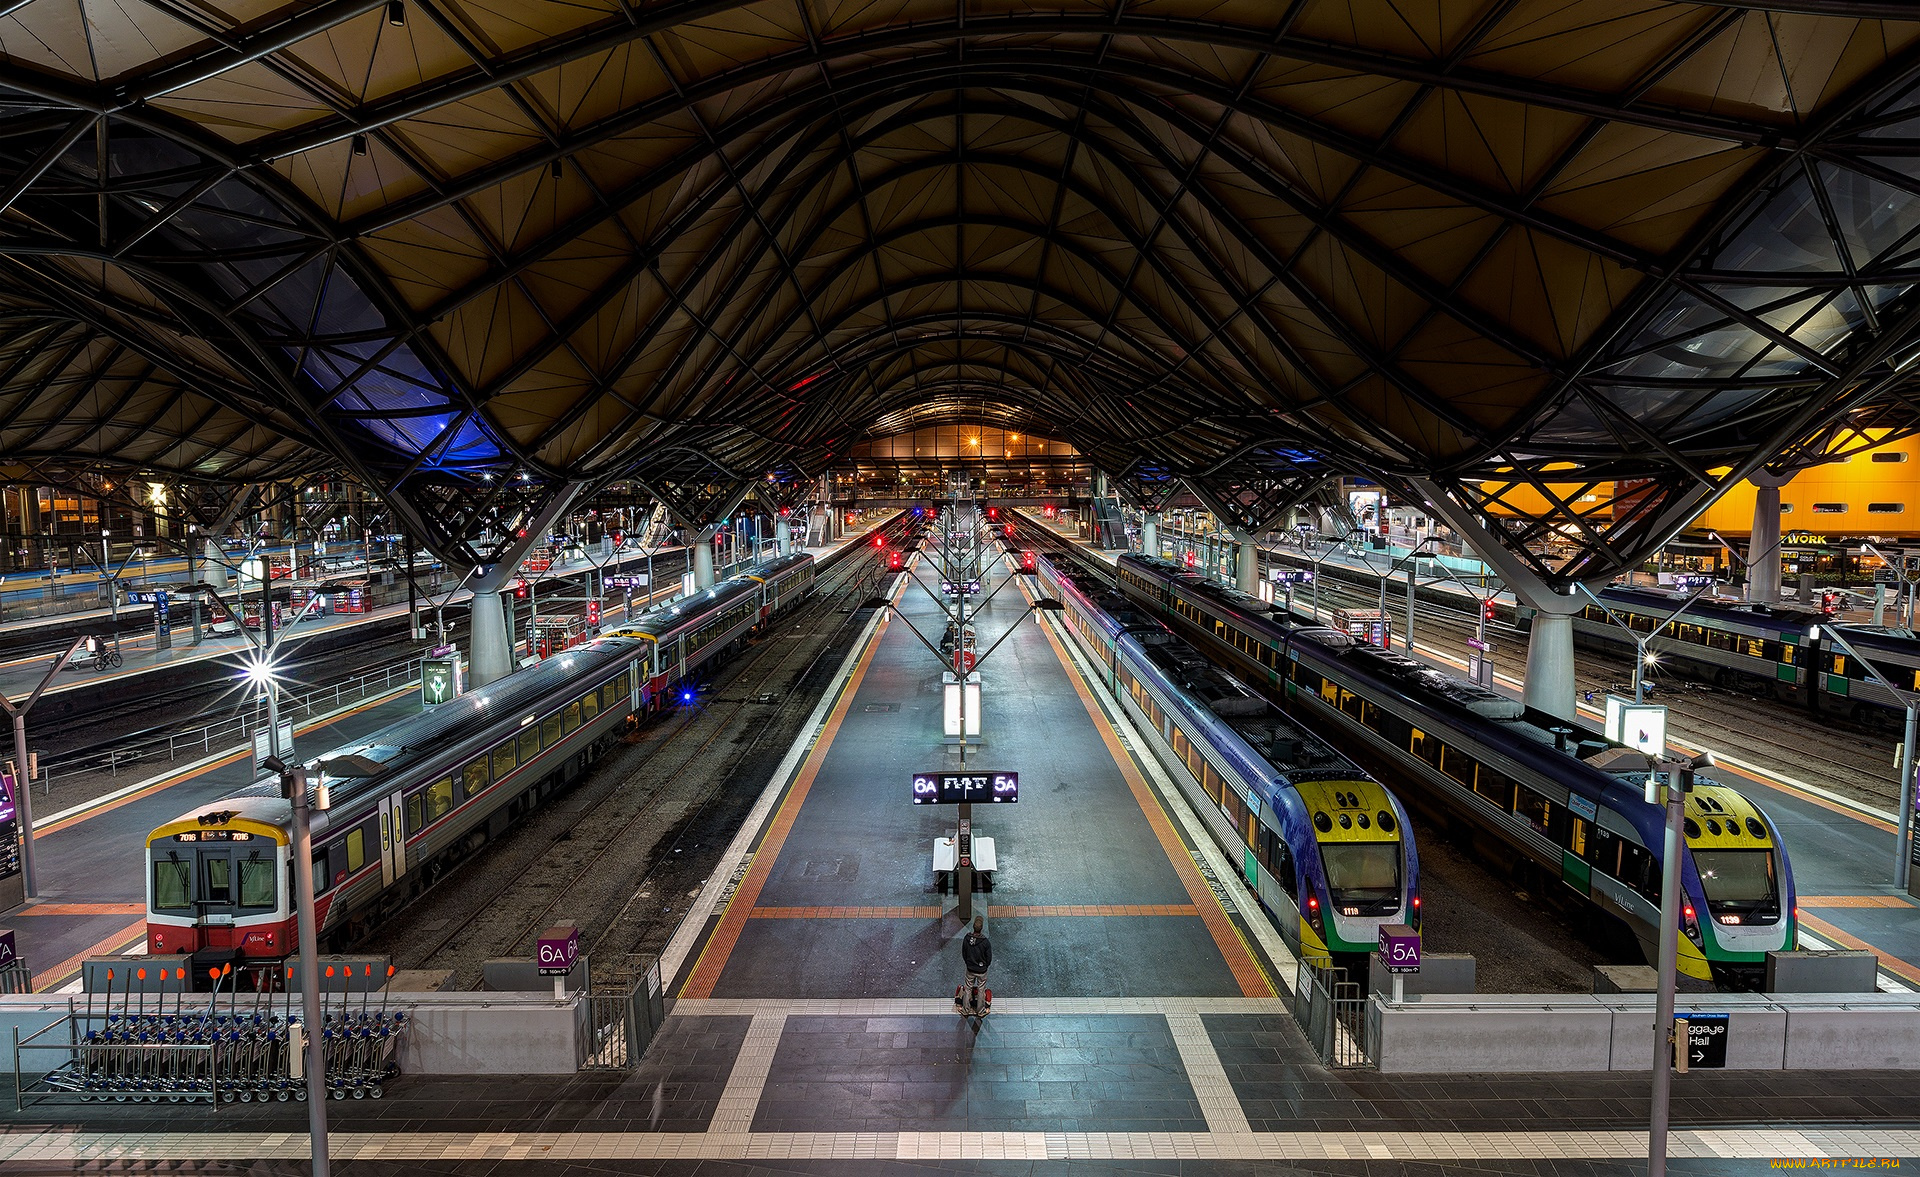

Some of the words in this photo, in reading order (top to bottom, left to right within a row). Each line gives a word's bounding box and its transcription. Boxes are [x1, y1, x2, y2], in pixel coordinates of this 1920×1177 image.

[914, 778, 937, 793] 6A
[994, 776, 1017, 792] 5A
[179, 833, 197, 842] 7016
[232, 832, 249, 841] 7016
[540, 944, 565, 963] 6A
[1392, 943, 1418, 961] 5A
[1689, 1036, 1710, 1046] Hall
